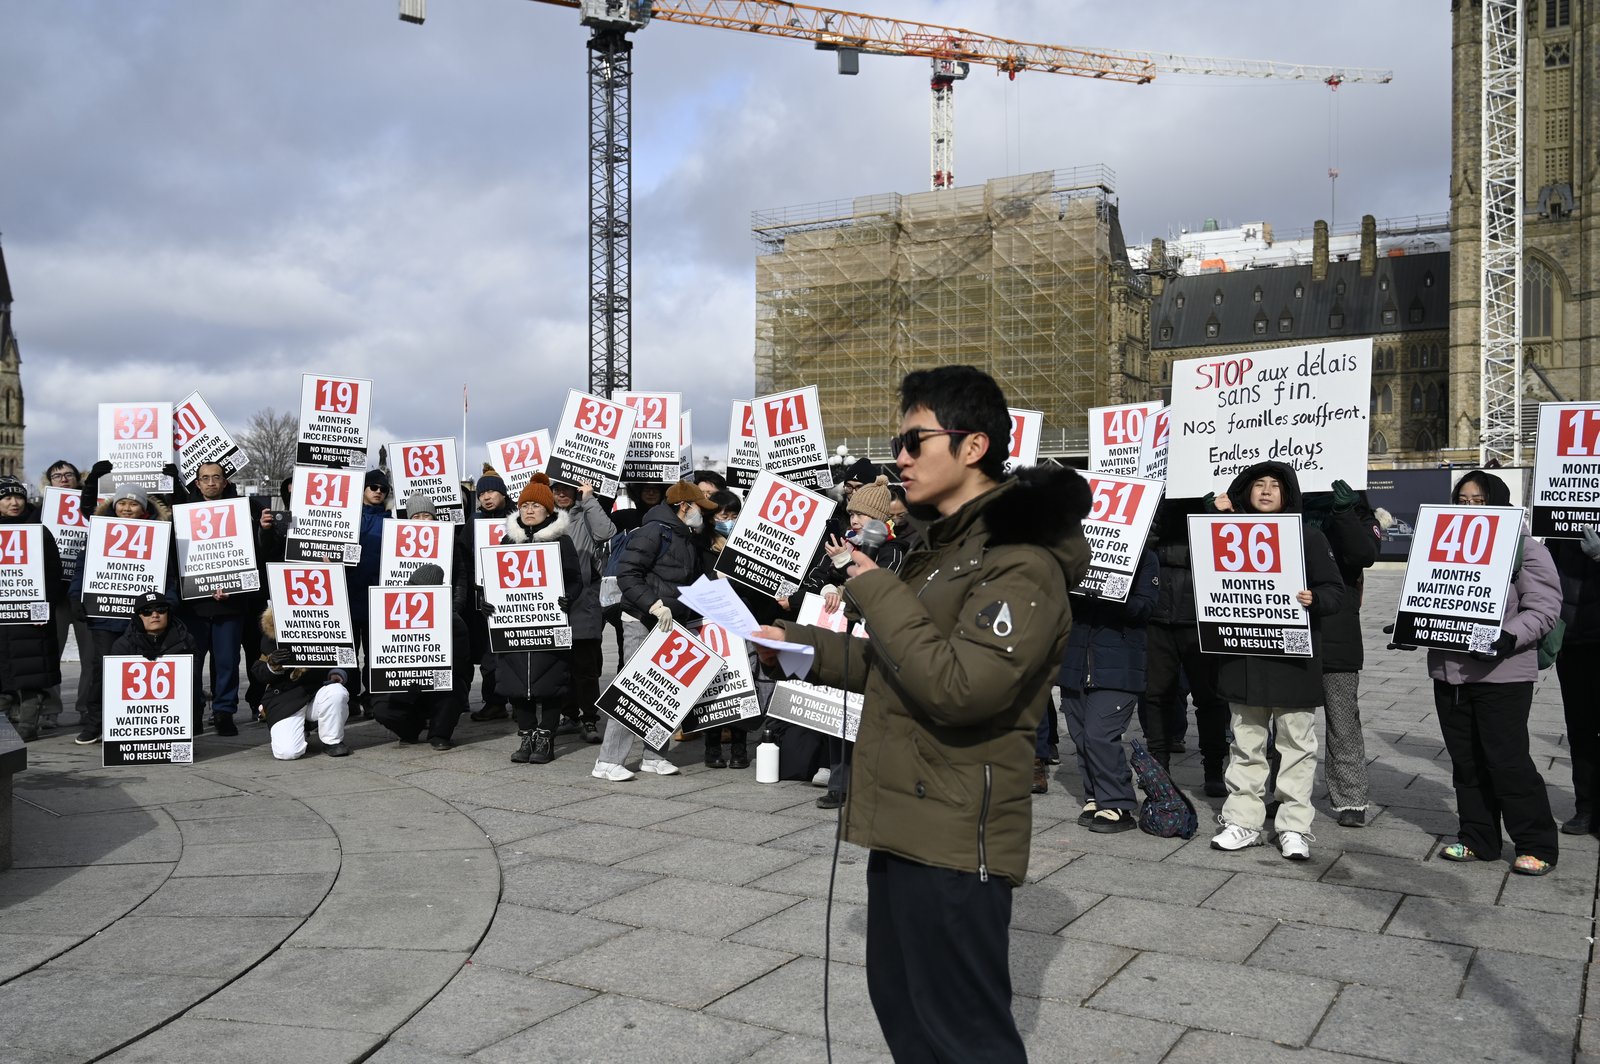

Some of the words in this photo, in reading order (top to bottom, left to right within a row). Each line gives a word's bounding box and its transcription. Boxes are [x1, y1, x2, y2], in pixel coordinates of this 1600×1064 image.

[1195, 358, 1253, 390] STOP
[1258, 366, 1289, 382] aux
[1297, 348, 1357, 377] délais
[321, 382, 352, 413] 19
[1218, 385, 1261, 408] sans
[1274, 381, 1316, 405] fin.
[318, 415, 351, 425] MONTHS
[580, 401, 616, 436] 39
[770, 398, 803, 434] 71
[1228, 409, 1288, 434] familles
[1291, 402, 1366, 427] souffrent.
[118, 408, 154, 439] 32
[309, 424, 341, 433] WAITING
[1108, 410, 1143, 443] 40
[303, 432, 320, 440] IRCC
[322, 434, 363, 444] RESPONSE
[576, 433, 609, 449] MONTHS
[774, 435, 805, 448] MONTHS
[181, 447, 208, 469] WAITING
[207, 436, 221, 449] FOR
[182, 434, 209, 458] MONTHS
[565, 439, 598, 455] WAITING
[599, 450, 615, 460] FOR
[768, 447, 799, 459] WAITING
[801, 444, 816, 453] FOR
[1210, 444, 1259, 463] Endless
[1269, 437, 1323, 460] delays
[506, 439, 538, 470] 22
[557, 447, 575, 458] IRCC
[575, 453, 617, 471] RESPONSE
[634, 450, 674, 458] RESPONSE
[408, 446, 440, 476] 63
[561, 462, 571, 470] NO
[765, 461, 781, 470] IRCC
[782, 453, 822, 467] RESPONSE
[1100, 457, 1135, 467] WAITING
[561, 471, 571, 479] NO
[411, 478, 442, 487] MONTHS
[1549, 477, 1599, 488] WAITING
[311, 474, 342, 506] 31
[1541, 491, 1566, 501] IRCC
[767, 487, 811, 531] 68
[1090, 481, 1133, 524] 51
[308, 509, 342, 518] MONTHS
[195, 506, 229, 539] 37
[299, 518, 332, 527] WAITING
[334, 521, 350, 529] FOR
[293, 526, 310, 535] IRCC
[312, 529, 354, 539] RESPONSE
[757, 523, 795, 545] MONTHS
[1437, 515, 1489, 563] 40
[107, 524, 147, 558] 24
[198, 541, 233, 551] MONTHS
[400, 526, 434, 557] 39
[744, 528, 781, 551] WAITING
[782, 546, 800, 560] FOR
[1106, 541, 1128, 552] FOR
[1219, 524, 1273, 572] 36
[189, 551, 225, 562] WAITING
[227, 549, 244, 557] FOR
[733, 537, 754, 551] IRCC
[753, 546, 801, 573] RESPONSE
[735, 556, 747, 565] NO
[107, 562, 145, 572] MONTHS
[184, 563, 204, 572] IRCC
[205, 558, 249, 570] RESPONSE
[502, 550, 542, 588] 34
[97, 572, 133, 581] WAITING
[137, 574, 154, 582] FOR
[734, 565, 746, 575] NO
[746, 571, 778, 590] RESULTS
[1431, 569, 1481, 582] MONTHS
[90, 582, 109, 590] IRCC
[111, 583, 158, 592] RESPONSE
[211, 581, 240, 590] RESULTS
[291, 570, 327, 604] 53
[1222, 579, 1275, 590] MONTHS
[1418, 582, 1464, 596] WAITING
[1467, 586, 1491, 598] FOR
[506, 592, 543, 602] MONTHS
[1210, 593, 1262, 604] WAITING
[1266, 594, 1290, 605] FOR
[390, 592, 428, 628] 42
[498, 604, 535, 613] WAITING
[537, 603, 554, 611] FOR
[1407, 596, 1432, 608] IRCC
[1433, 598, 1496, 613] RESPONSE
[293, 610, 329, 618] MONTHS
[494, 615, 513, 624] IRCC
[514, 613, 561, 623] RESPONSE
[1204, 606, 1231, 617] IRCC
[1233, 607, 1299, 619] RESPONSE
[285, 620, 321, 628] WAITING
[301, 631, 347, 639] RESPONSE
[516, 628, 554, 637] TIMELINES
[1219, 627, 1232, 635] NO
[392, 634, 430, 642] MONTHS
[520, 638, 552, 646] RESULTS
[1224, 638, 1238, 647] NO
[1241, 639, 1285, 649] RESULTS
[382, 644, 420, 653] WAITING
[423, 644, 440, 652] FOR
[377, 656, 396, 664] IRCC
[398, 654, 446, 663] RESPONSE
[659, 637, 706, 680] 37
[127, 662, 170, 699] 36
[647, 668, 680, 695] MONTHS
[723, 670, 740, 682] FOR
[633, 671, 665, 698] WAITING
[663, 695, 680, 710] FOR
[702, 679, 748, 698] RESPONSE
[620, 677, 639, 694] IRCC
[637, 690, 678, 722] RESPONSE
[127, 705, 169, 714] MONTHS
[693, 706, 704, 716] NO
[698, 715, 709, 724] NO
[710, 706, 740, 721] RESULTS
[116, 716, 157, 725] WAITING
[161, 716, 179, 724] FOR
[804, 712, 841, 728] RESULTS
[110, 728, 131, 736] IRCC
[134, 727, 185, 736] RESPONSE
